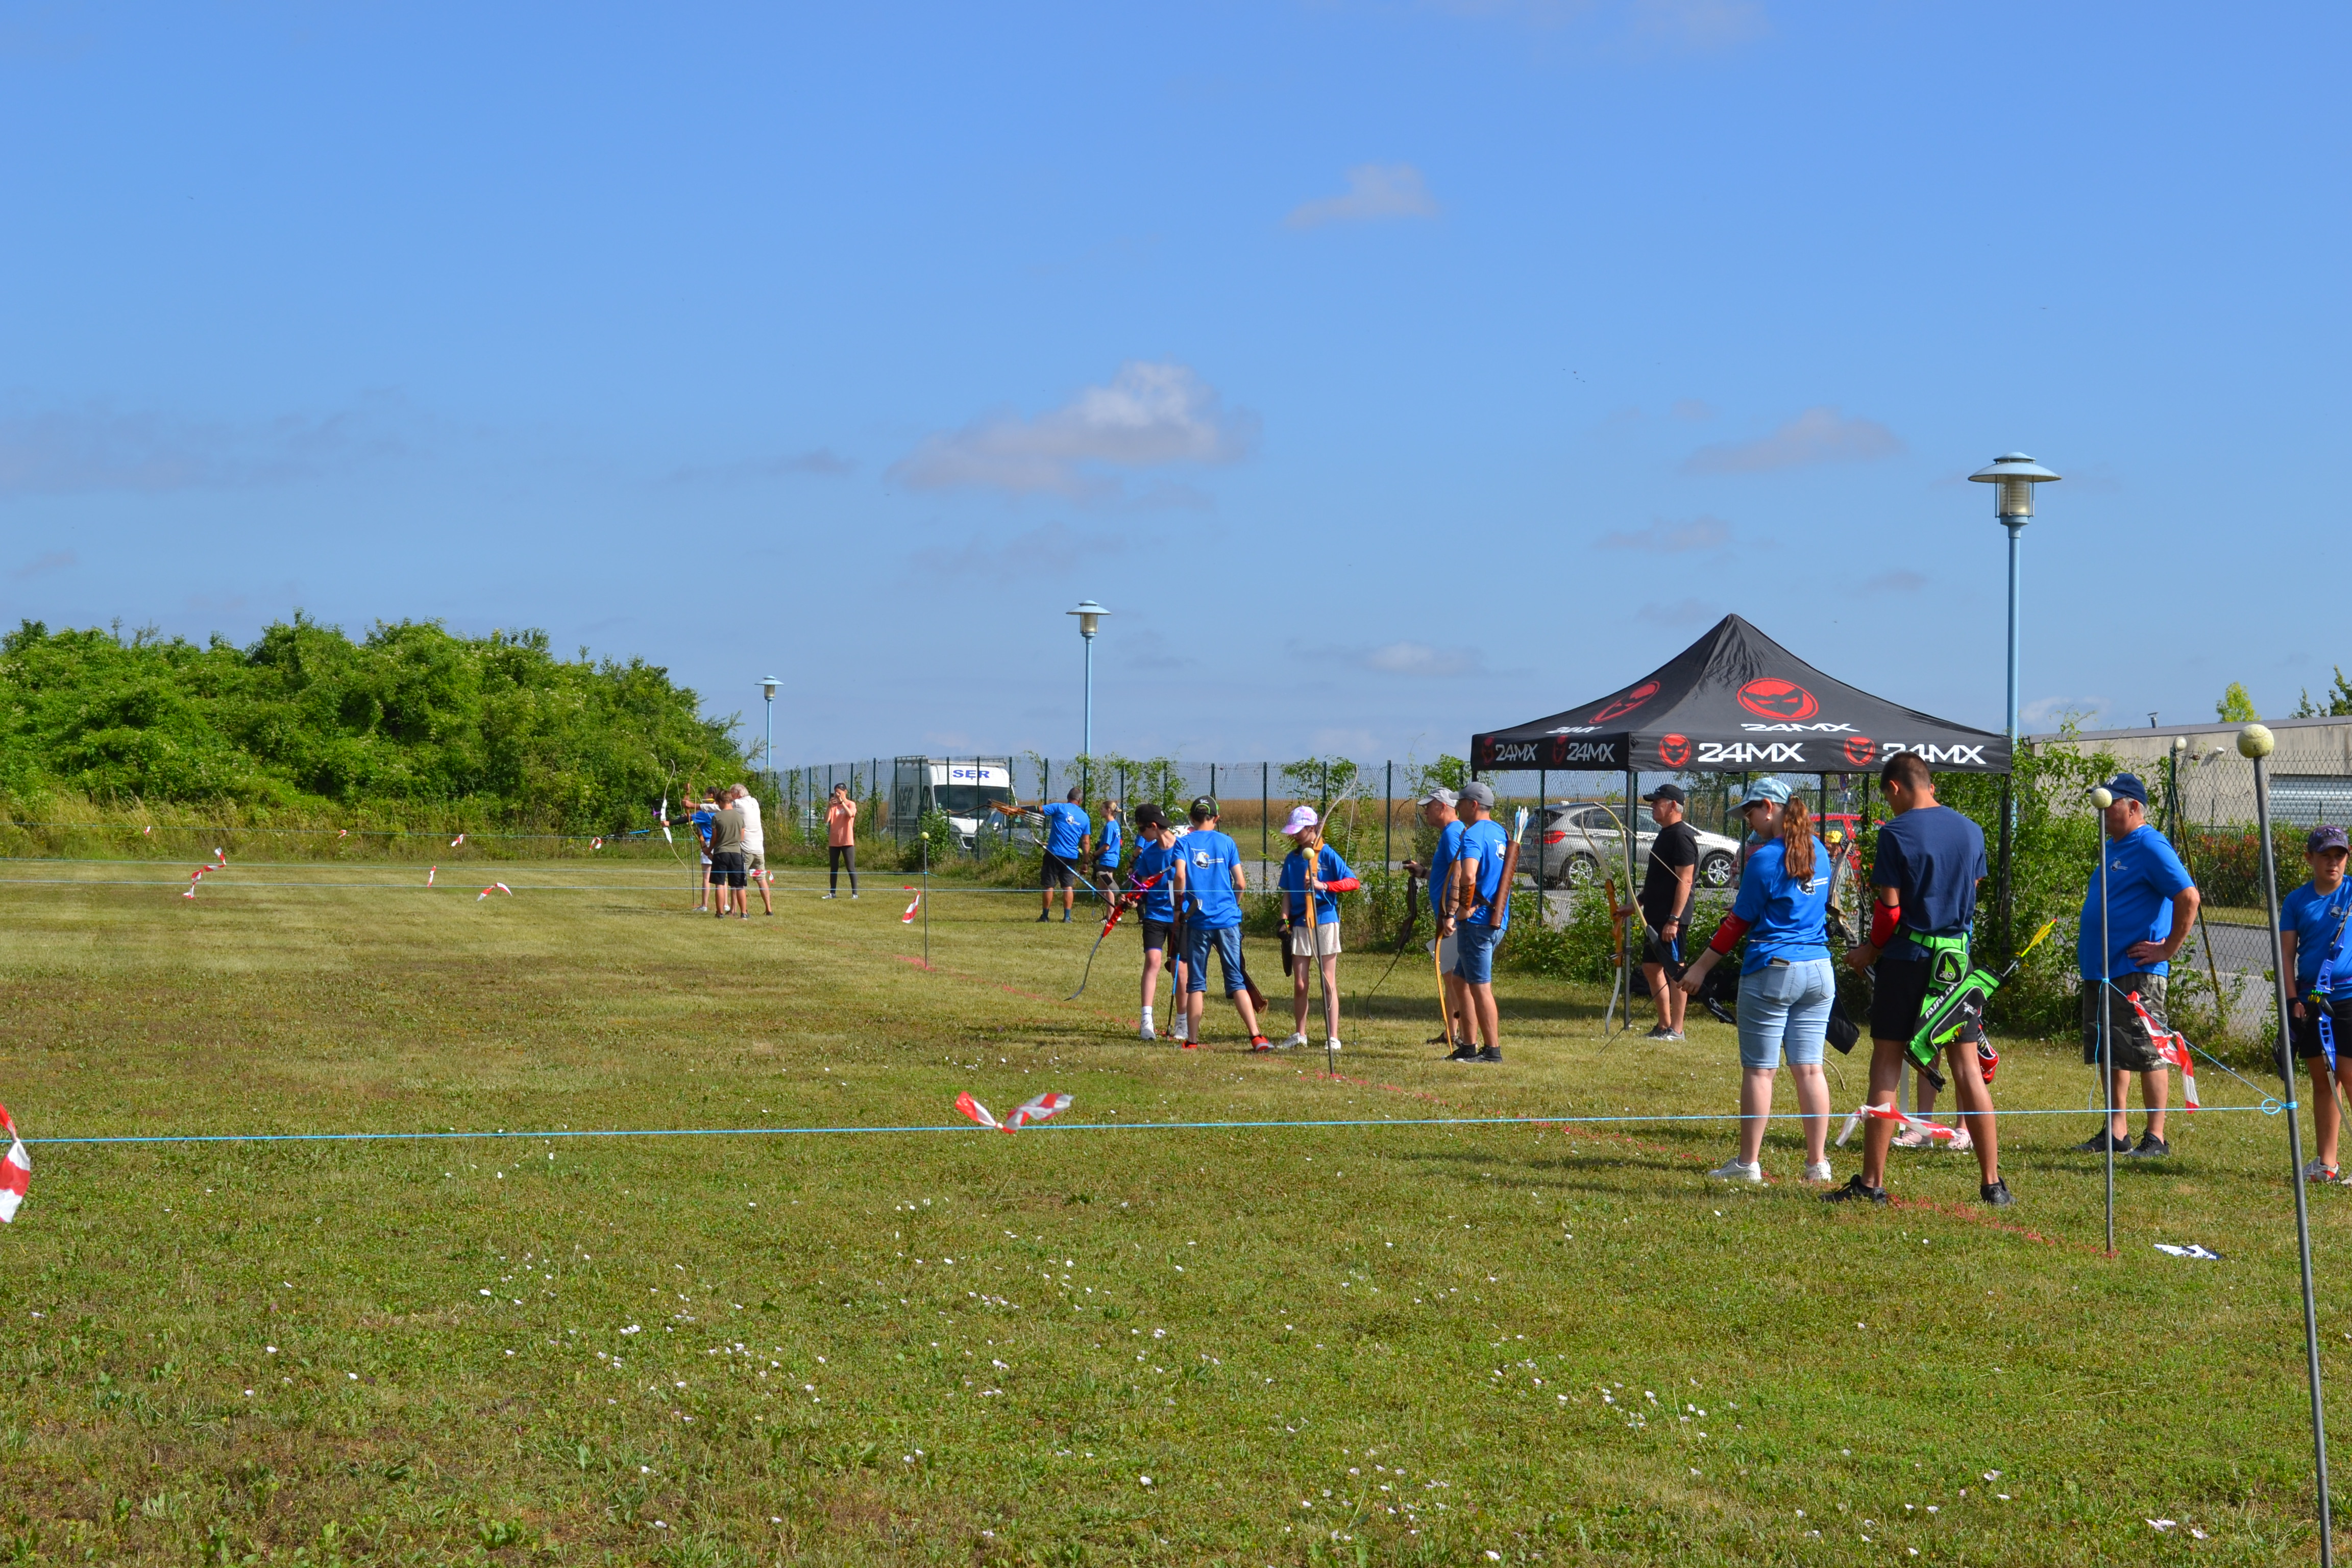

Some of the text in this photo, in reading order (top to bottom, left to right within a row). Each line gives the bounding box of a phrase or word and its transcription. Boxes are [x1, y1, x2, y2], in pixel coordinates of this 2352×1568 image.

[1741, 723, 1860, 732] 24MX
[1496, 744, 1538, 761] 24MX
[1567, 743, 1615, 762] 24MX
[1698, 743, 1806, 762] 24MX
[1881, 743, 1987, 764] 24MX
[952, 770, 990, 778] SER
[897, 786, 914, 812] SER
